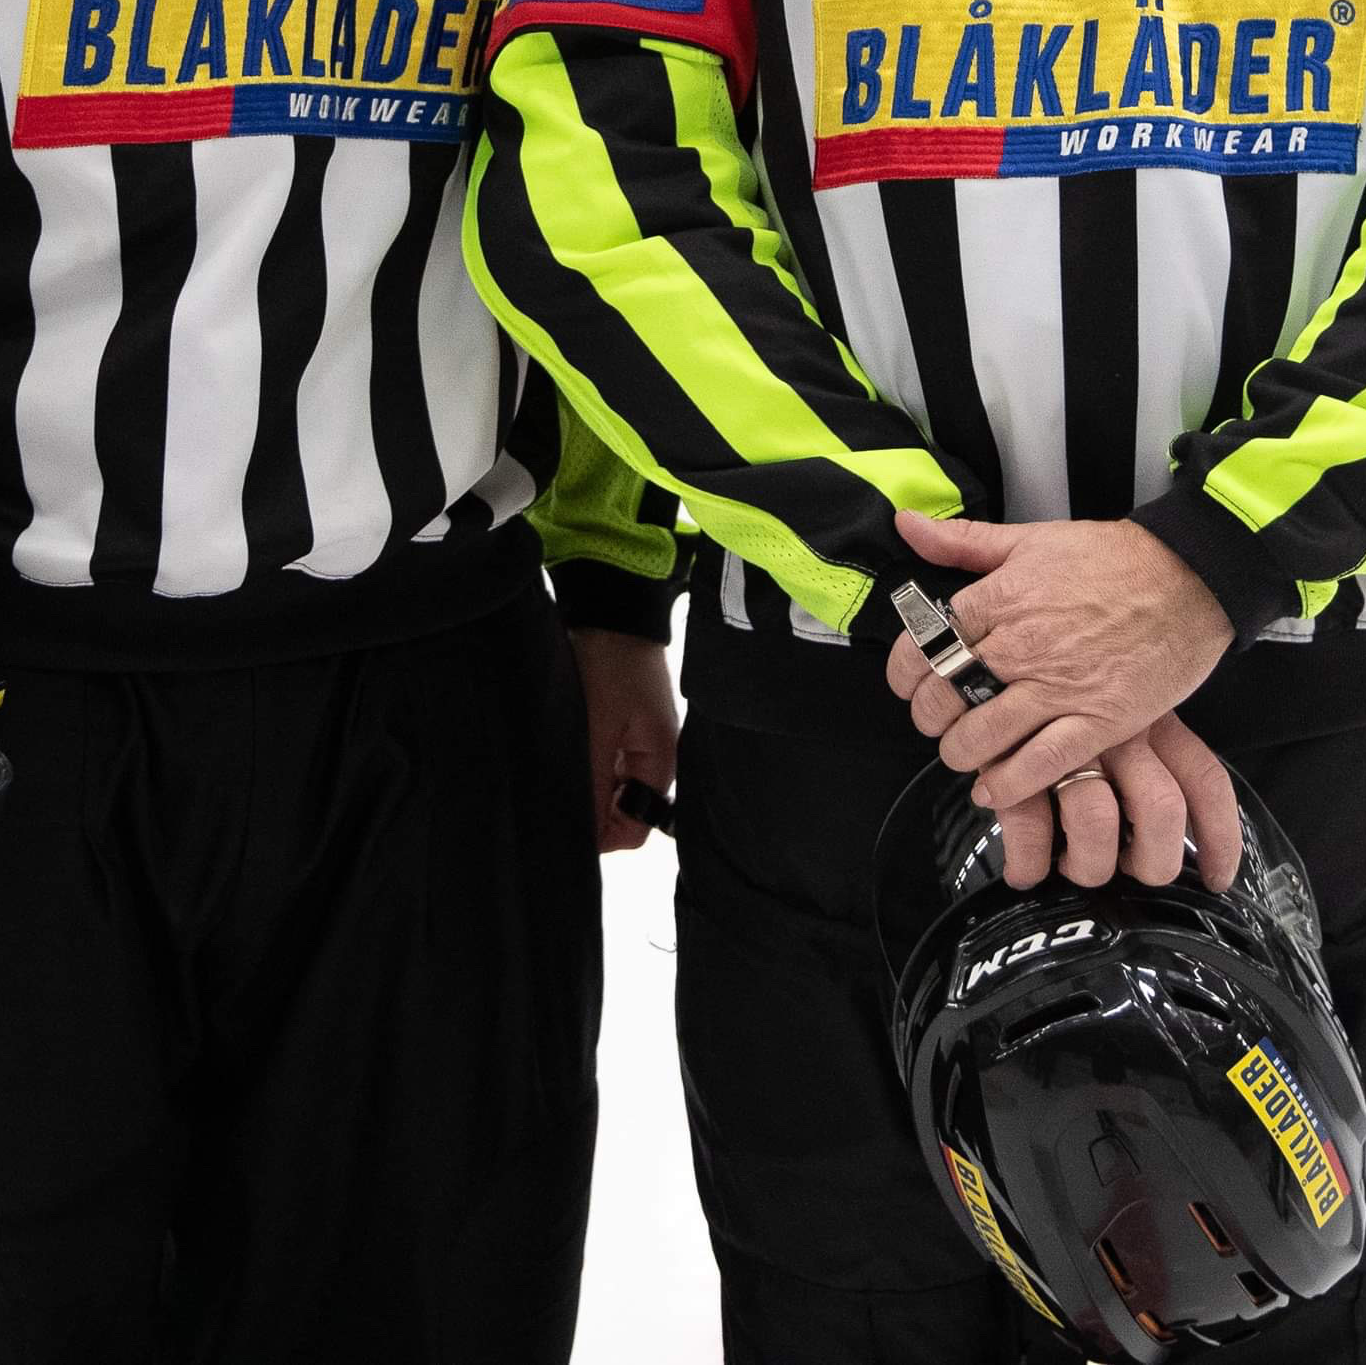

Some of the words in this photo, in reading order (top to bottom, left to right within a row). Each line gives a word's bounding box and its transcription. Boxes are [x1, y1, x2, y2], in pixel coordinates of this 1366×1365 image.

[1059, 122, 1310, 156] WORKWEAR
[966, 919, 1095, 991] CCM
[1273, 1057, 1319, 1128] WORKWEAR
[1240, 1055, 1339, 1217] BLÅKLÄDER
